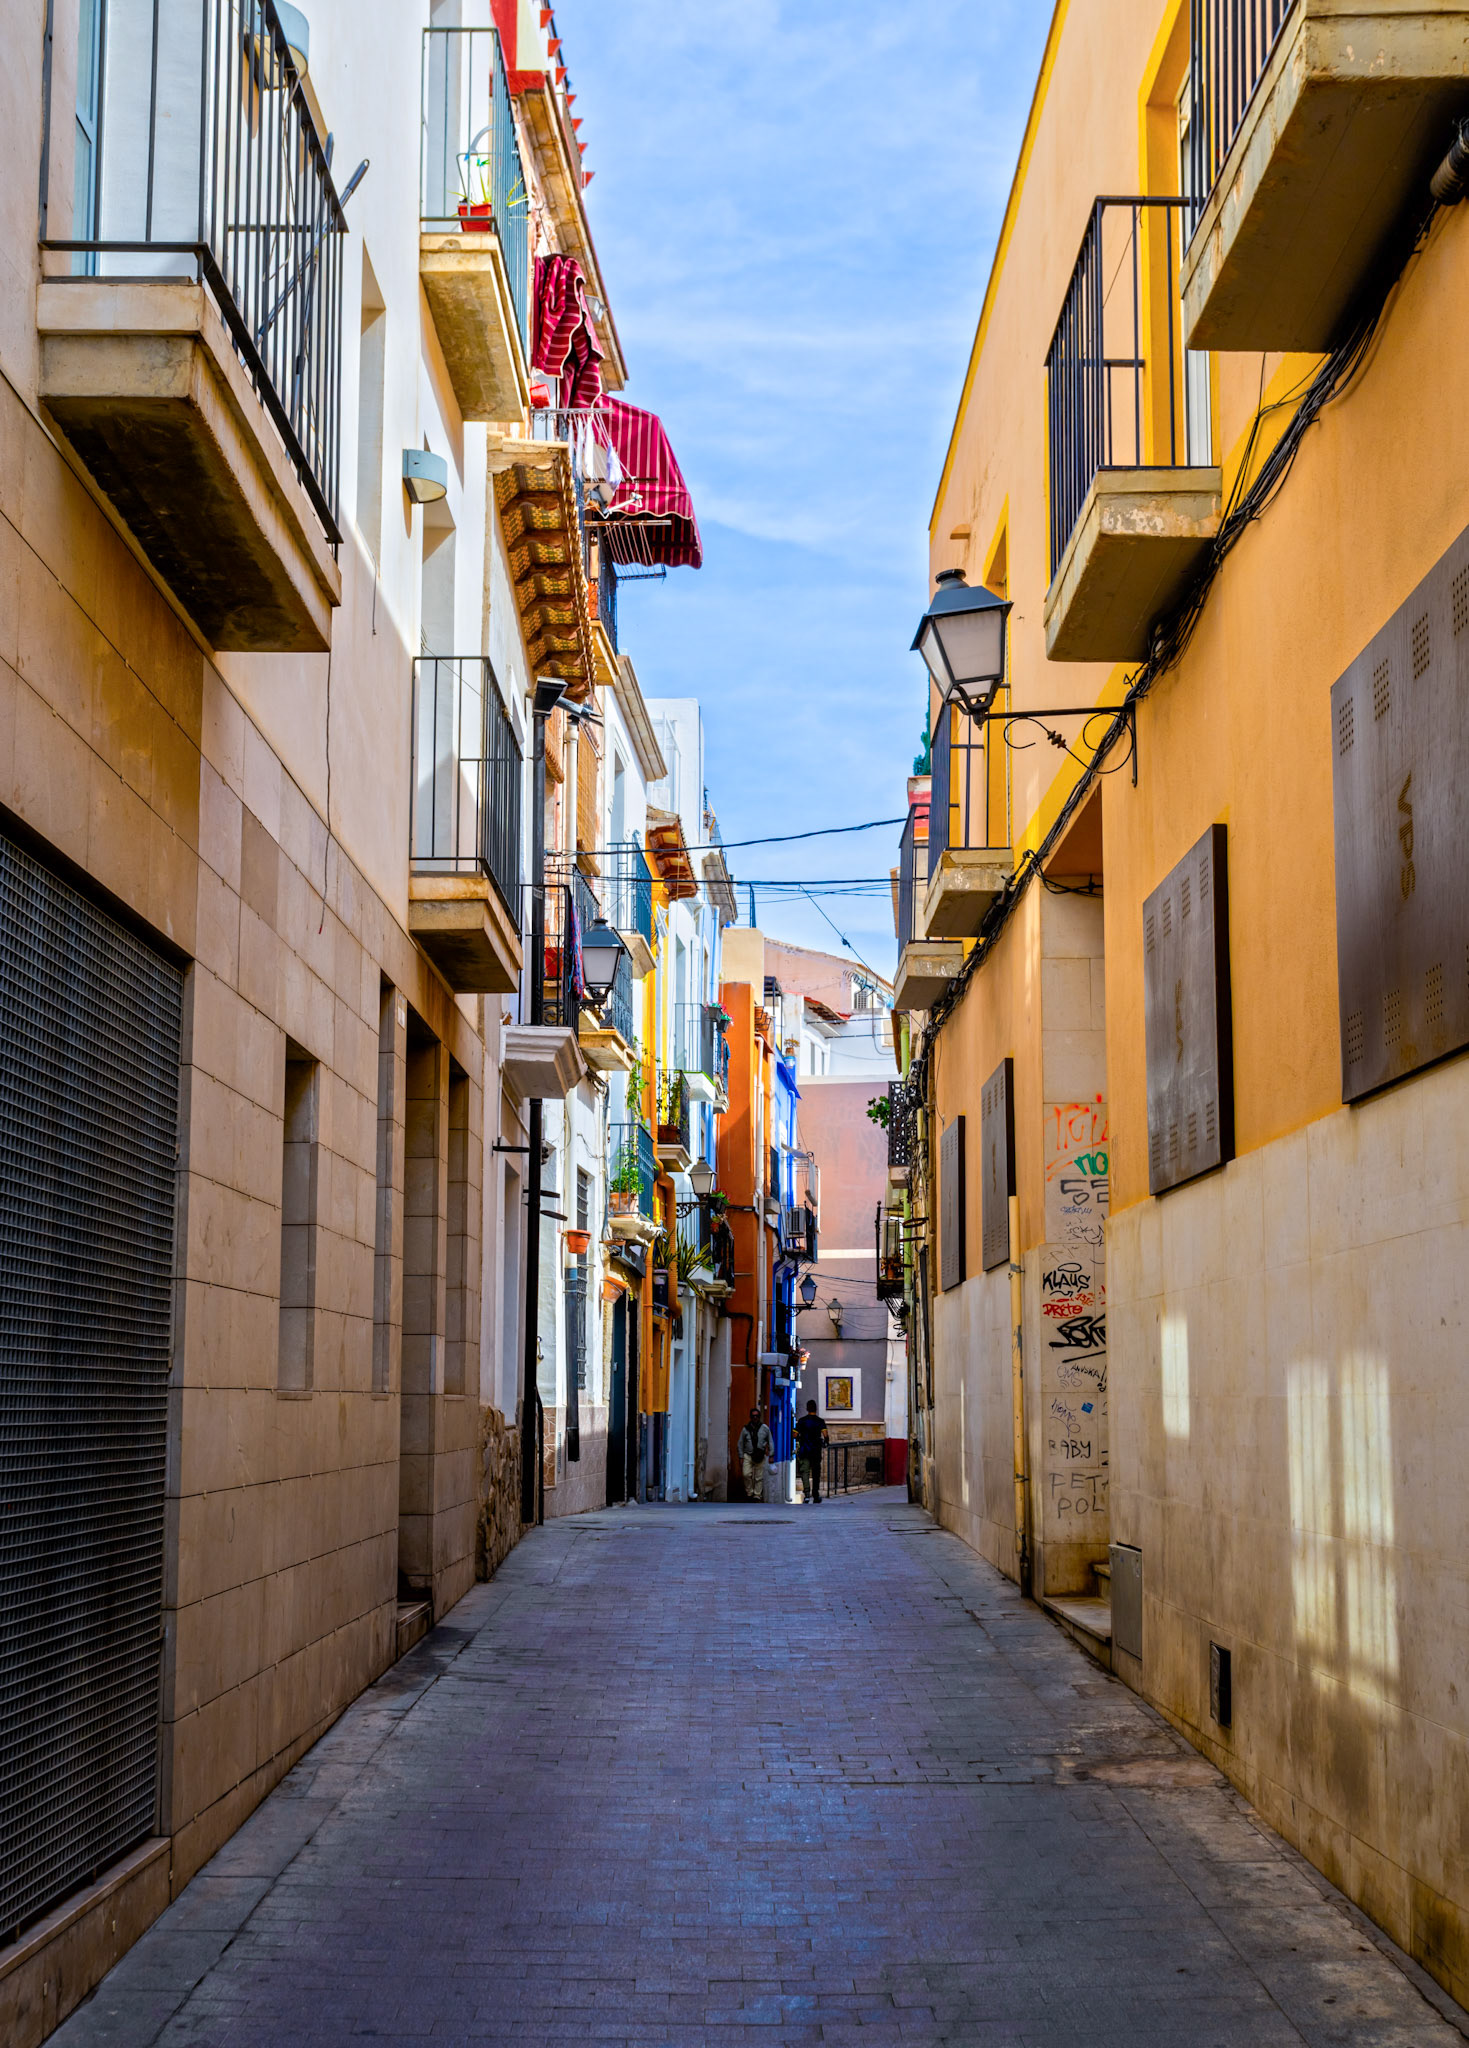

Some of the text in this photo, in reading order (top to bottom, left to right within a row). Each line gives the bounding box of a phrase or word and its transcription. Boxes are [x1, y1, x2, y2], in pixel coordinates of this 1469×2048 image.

[1042, 1270, 1091, 1293] KLAUS
[1048, 1439, 1091, 1459] BABY
[1058, 1497, 1105, 1519] POL
